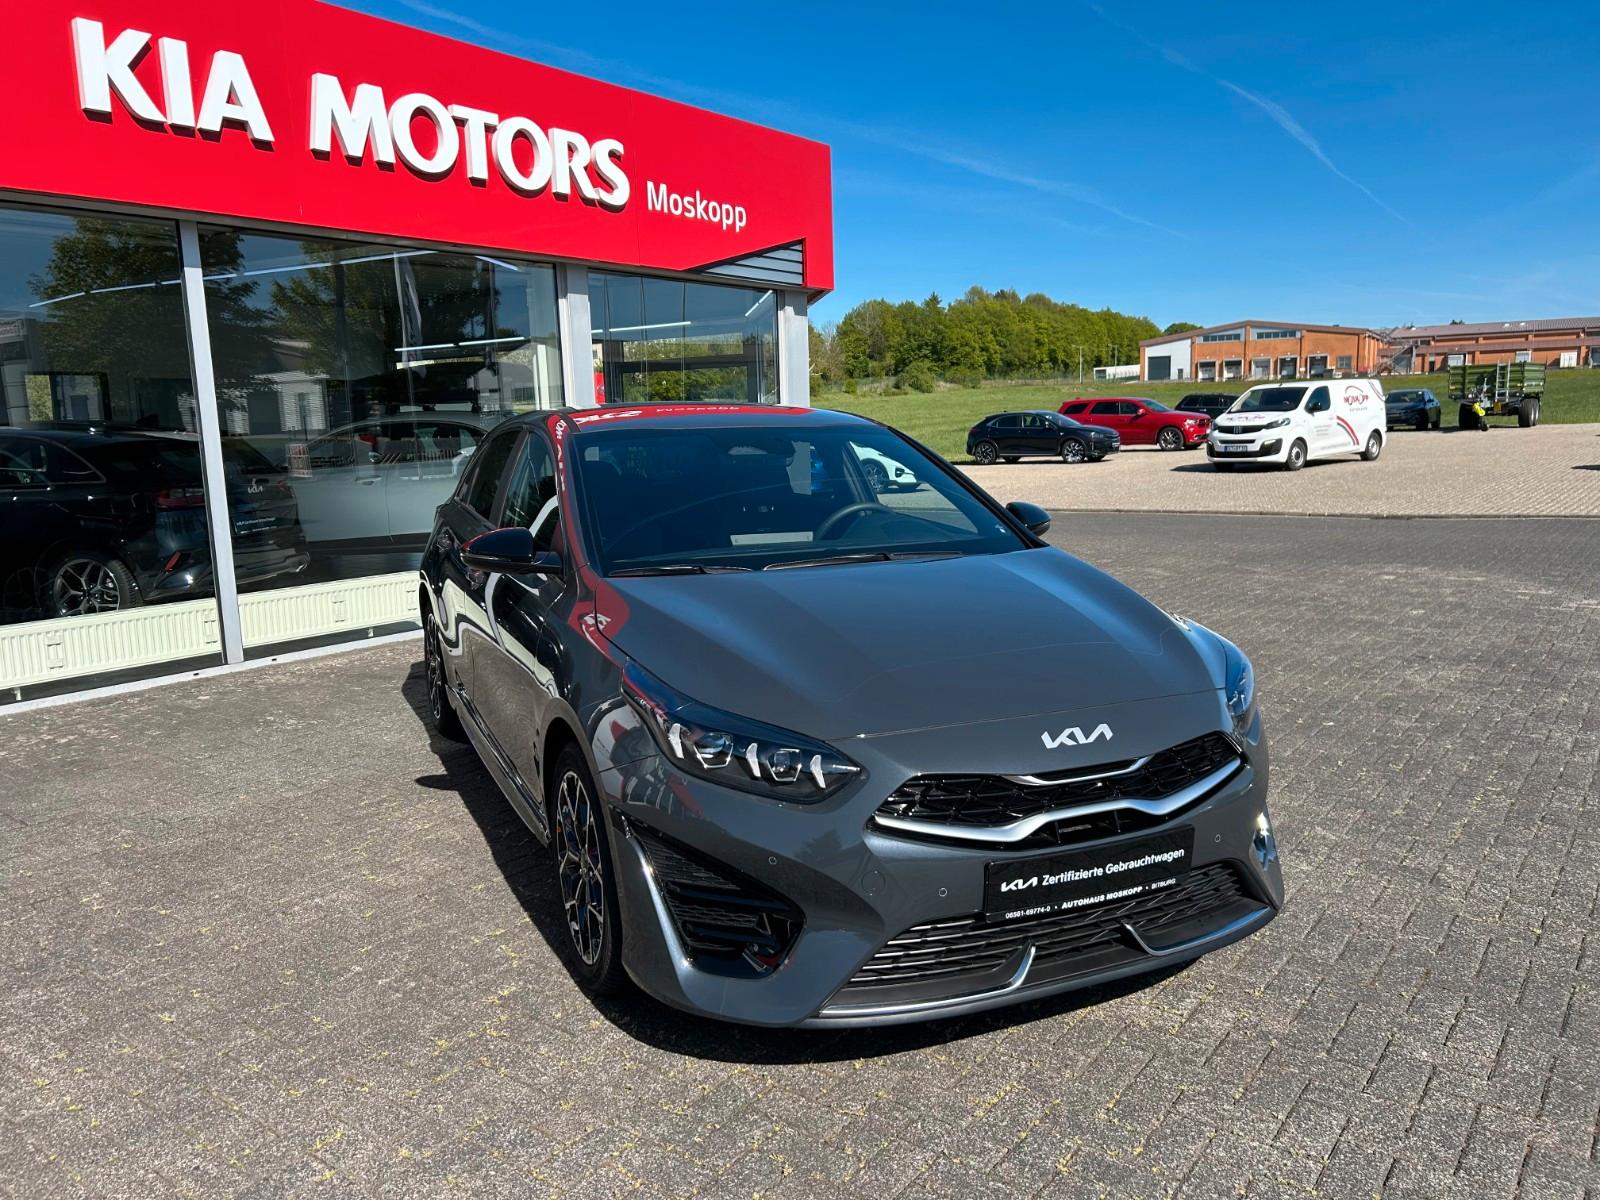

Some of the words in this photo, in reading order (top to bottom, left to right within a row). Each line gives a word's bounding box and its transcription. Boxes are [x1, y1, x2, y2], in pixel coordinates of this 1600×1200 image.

[71, 16, 275, 147] KIA
[310, 72, 630, 209] MOTORS
[646, 181, 748, 233] Moskopp
[1041, 723, 1113, 749] KIA
[1001, 876, 1038, 892] KIA
[1042, 867, 1103, 886] Zertifizierte
[1105, 848, 1185, 874] Gebrauchtwagen
[1062, 894, 1105, 909] AUTOHAUS
[1106, 886, 1142, 900] MOSKOPP
